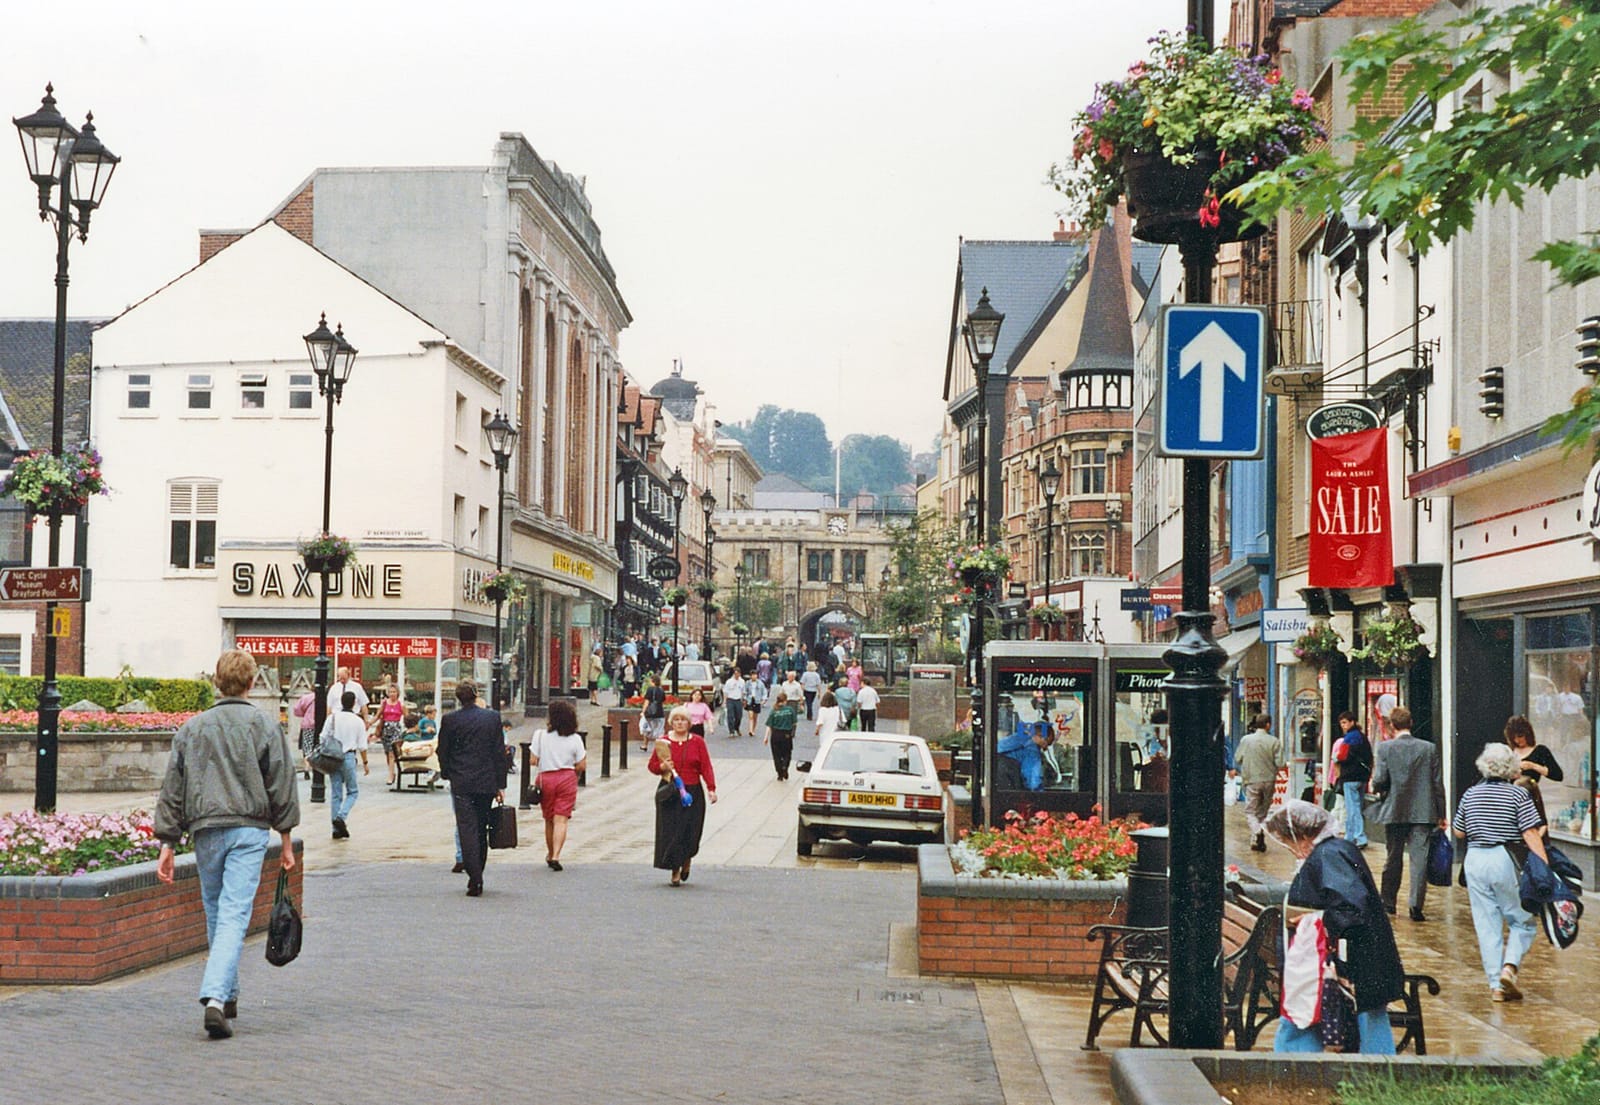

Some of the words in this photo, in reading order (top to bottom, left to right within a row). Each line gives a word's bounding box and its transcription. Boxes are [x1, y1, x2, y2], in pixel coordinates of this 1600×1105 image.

[1317, 485, 1382, 535] SALE
[28, 571, 47, 581] Cycle
[16, 581, 43, 589] Museum
[42, 589, 57, 597] Pool
[1264, 618, 1307, 631] Salisbu
[268, 642, 299, 654] SALE
[337, 643, 366, 654] SALE
[369, 643, 400, 655] SALE
[1013, 673, 1077, 690] Telephone
[1128, 674, 1164, 688] Phon
